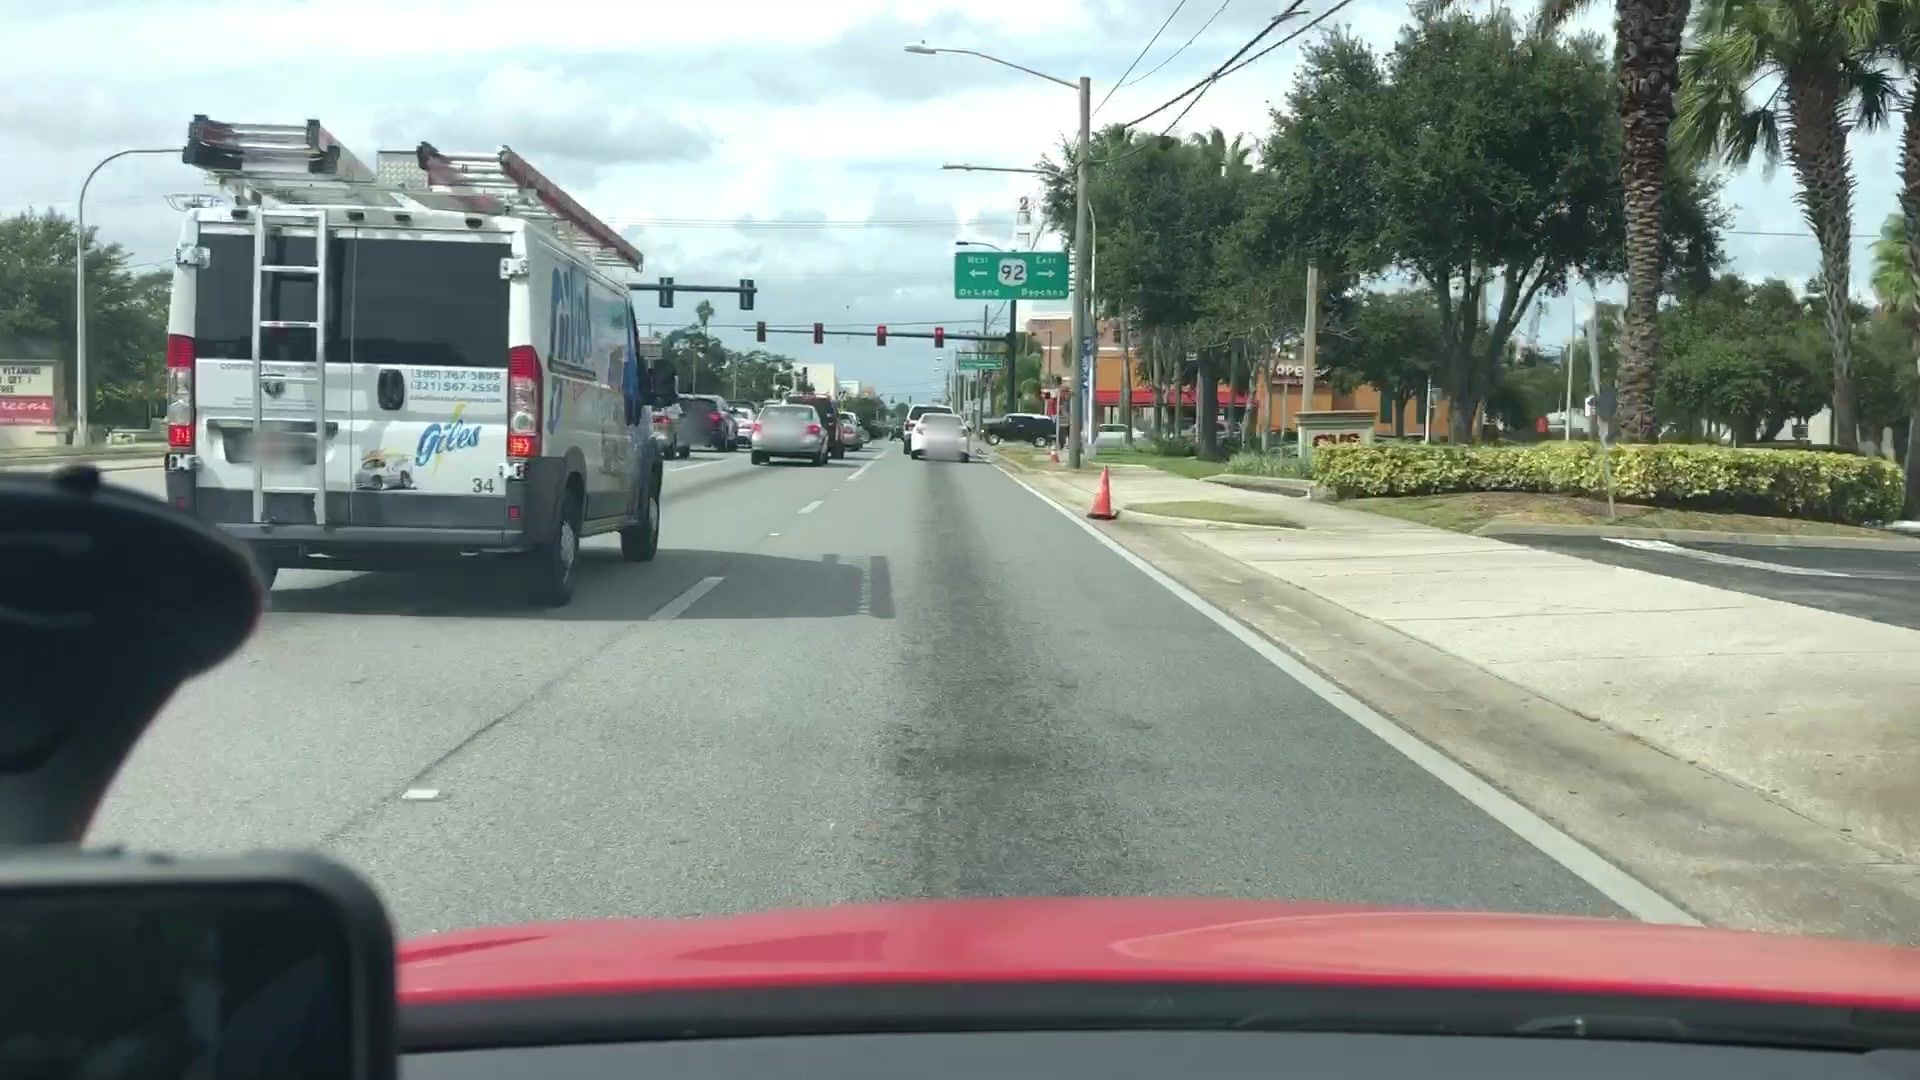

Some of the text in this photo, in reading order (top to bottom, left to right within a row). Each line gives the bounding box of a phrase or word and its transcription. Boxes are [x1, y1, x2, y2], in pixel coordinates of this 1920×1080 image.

[1001, 264, 1024, 280] 92
[410, 382, 440, 391] (321)
[415, 418, 482, 467] Giles
[472, 477, 494, 493] 34
